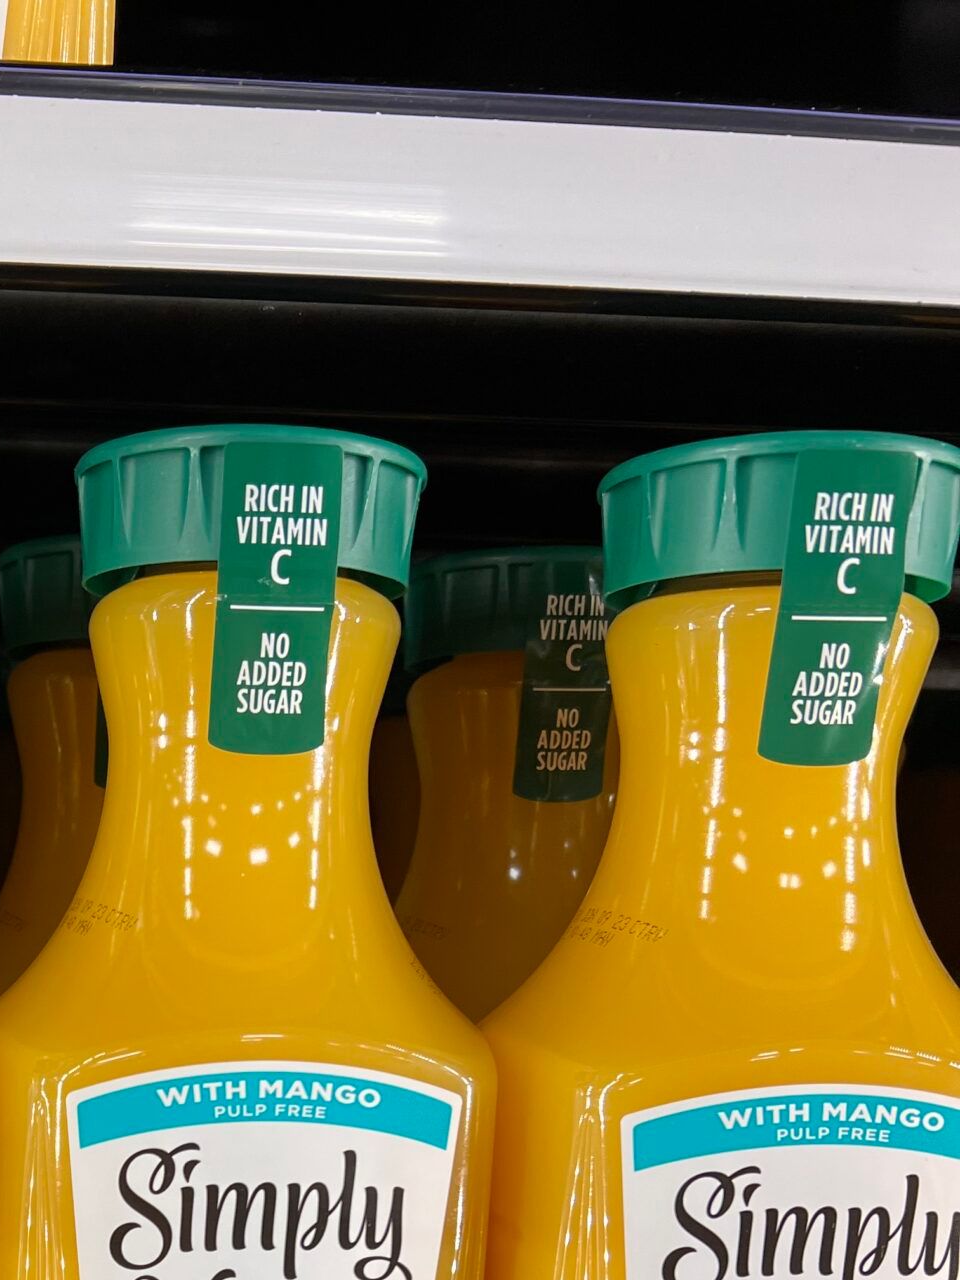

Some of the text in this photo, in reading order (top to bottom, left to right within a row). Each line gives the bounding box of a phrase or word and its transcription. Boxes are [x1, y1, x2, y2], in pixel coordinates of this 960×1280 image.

[244, 484, 323, 514] RICH IN
[813, 492, 895, 522] RICH IN
[236, 516, 328, 546] VITAMIN
[804, 525, 895, 555] VITAMIN
[270, 549, 292, 585] C
[836, 558, 860, 595] C
[546, 595, 605, 616] RICH IN
[540, 619, 609, 641] VITAMIN
[260, 633, 290, 658] NO
[565, 645, 582, 672] C
[819, 643, 850, 669] NO
[236, 661, 307, 687] ADDED
[792, 672, 862, 697] ADDED
[236, 689, 302, 715] SUGAR
[790, 700, 856, 725] SUGAR
[556, 708, 580, 728] NO
[537, 730, 592, 751] ADDED
[536, 752, 588, 772] SUGAR
[156, 1079, 382, 1108] WITH MANGO
[214, 1104, 327, 1119] PULP FREE
[717, 1102, 946, 1132] WITH MANGO
[776, 1127, 890, 1142] PULP FREE
